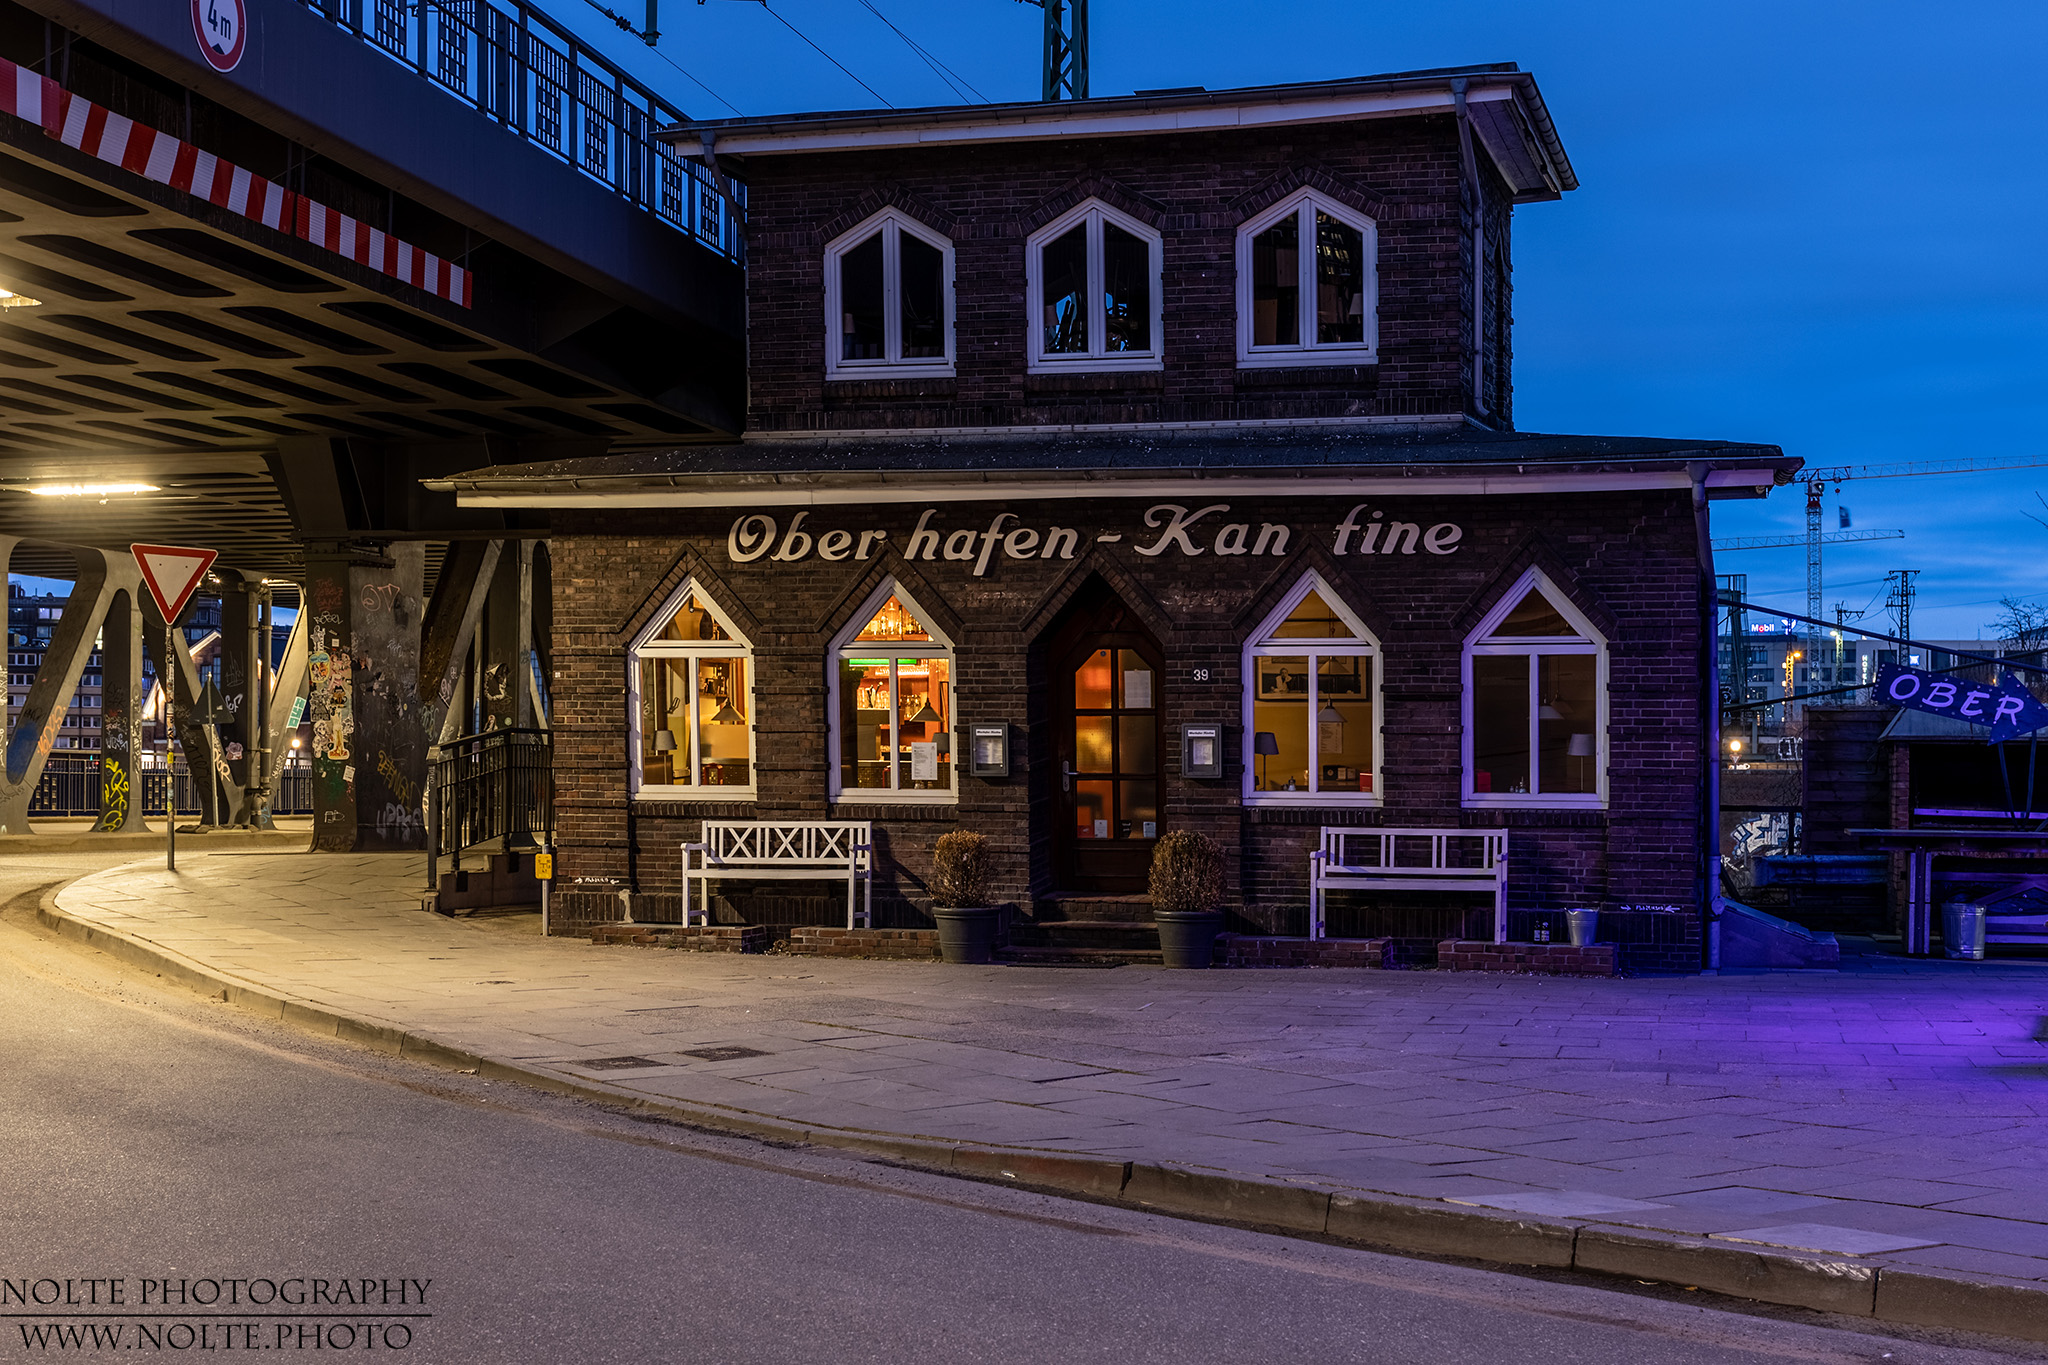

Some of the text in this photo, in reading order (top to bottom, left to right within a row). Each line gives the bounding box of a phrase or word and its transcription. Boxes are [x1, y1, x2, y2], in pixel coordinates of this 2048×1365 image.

[728, 511, 887, 562] Ober
[904, 509, 1079, 576] hafen
[1134, 504, 1291, 556] Kan
[1751, 624, 1775, 633] Mobil
[1193, 669, 1209, 681] 39
[1889, 674, 2024, 726] OBER
